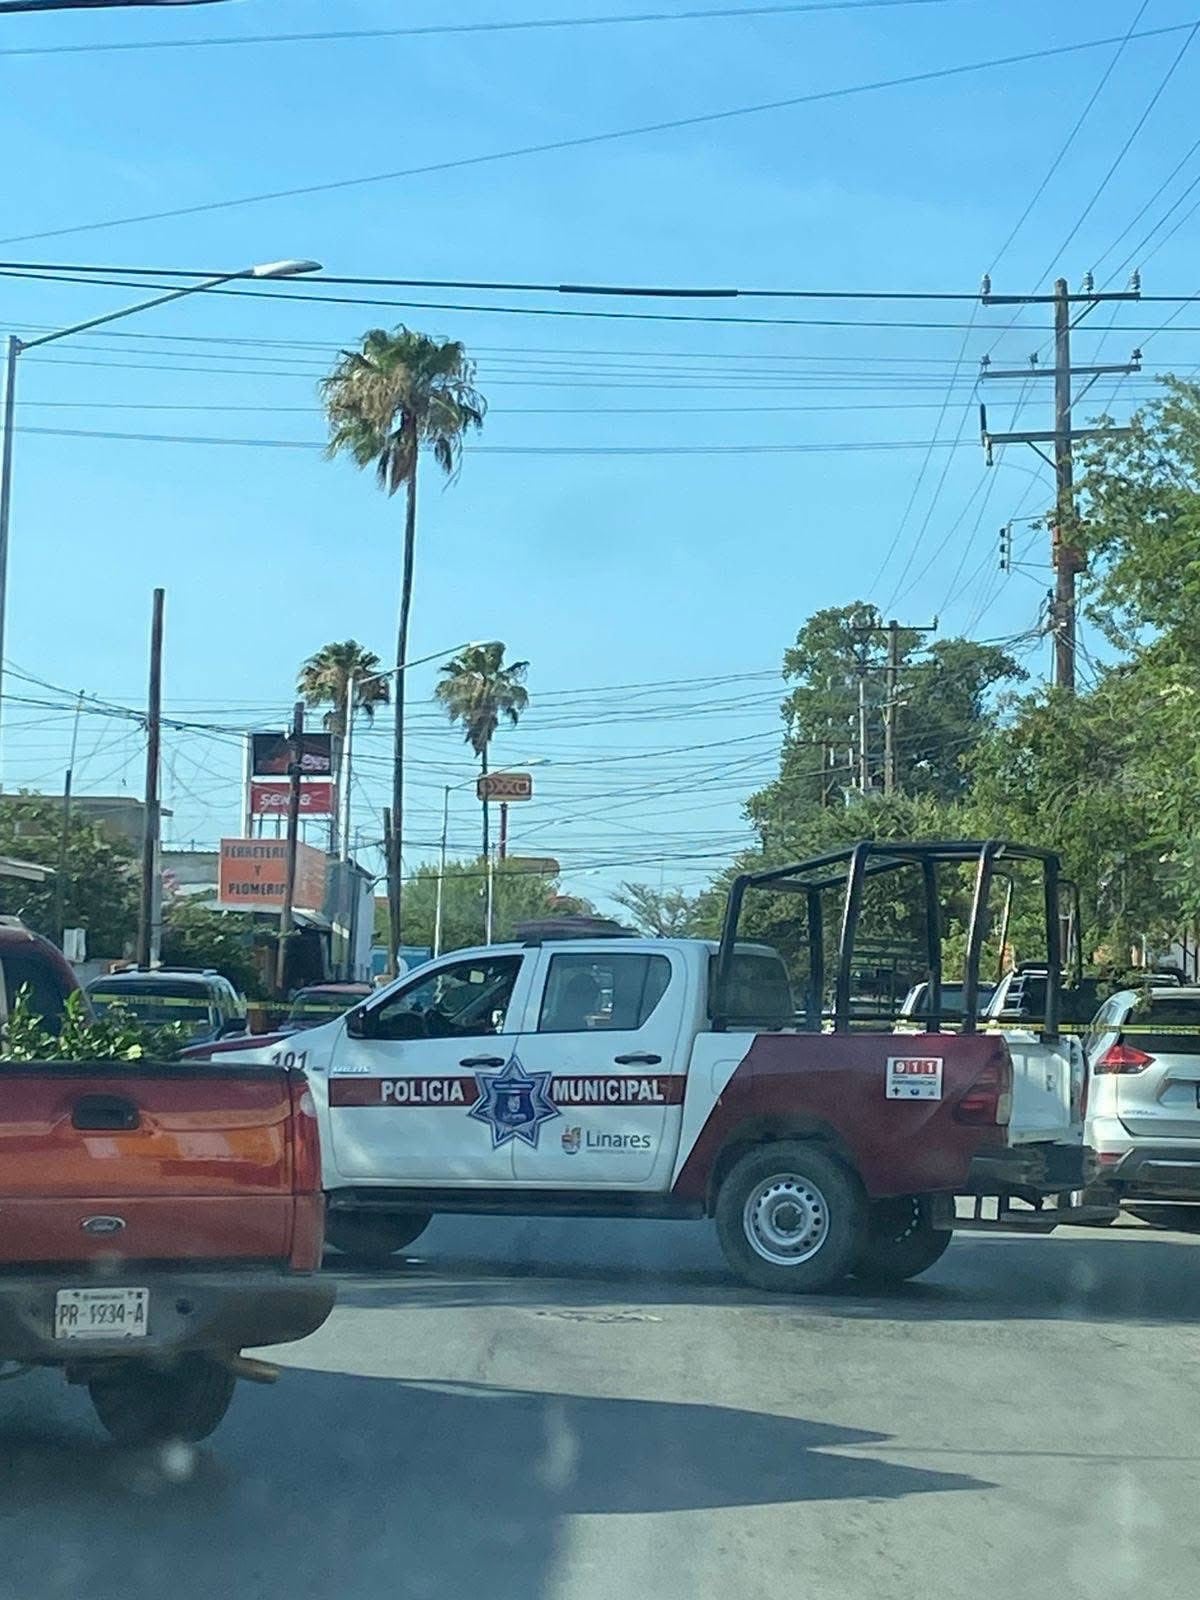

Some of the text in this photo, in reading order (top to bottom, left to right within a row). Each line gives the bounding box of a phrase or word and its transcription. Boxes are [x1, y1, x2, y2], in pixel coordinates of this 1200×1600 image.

[479, 779, 531, 794] OXXO
[225, 846, 288, 859] FERRETERI
[254, 865, 261, 876] Y
[271, 1051, 308, 1072] 101
[895, 1061, 935, 1074] 911
[381, 1079, 664, 1102] POLICIA MUNICIPAL
[586, 1130, 651, 1149] Linares
